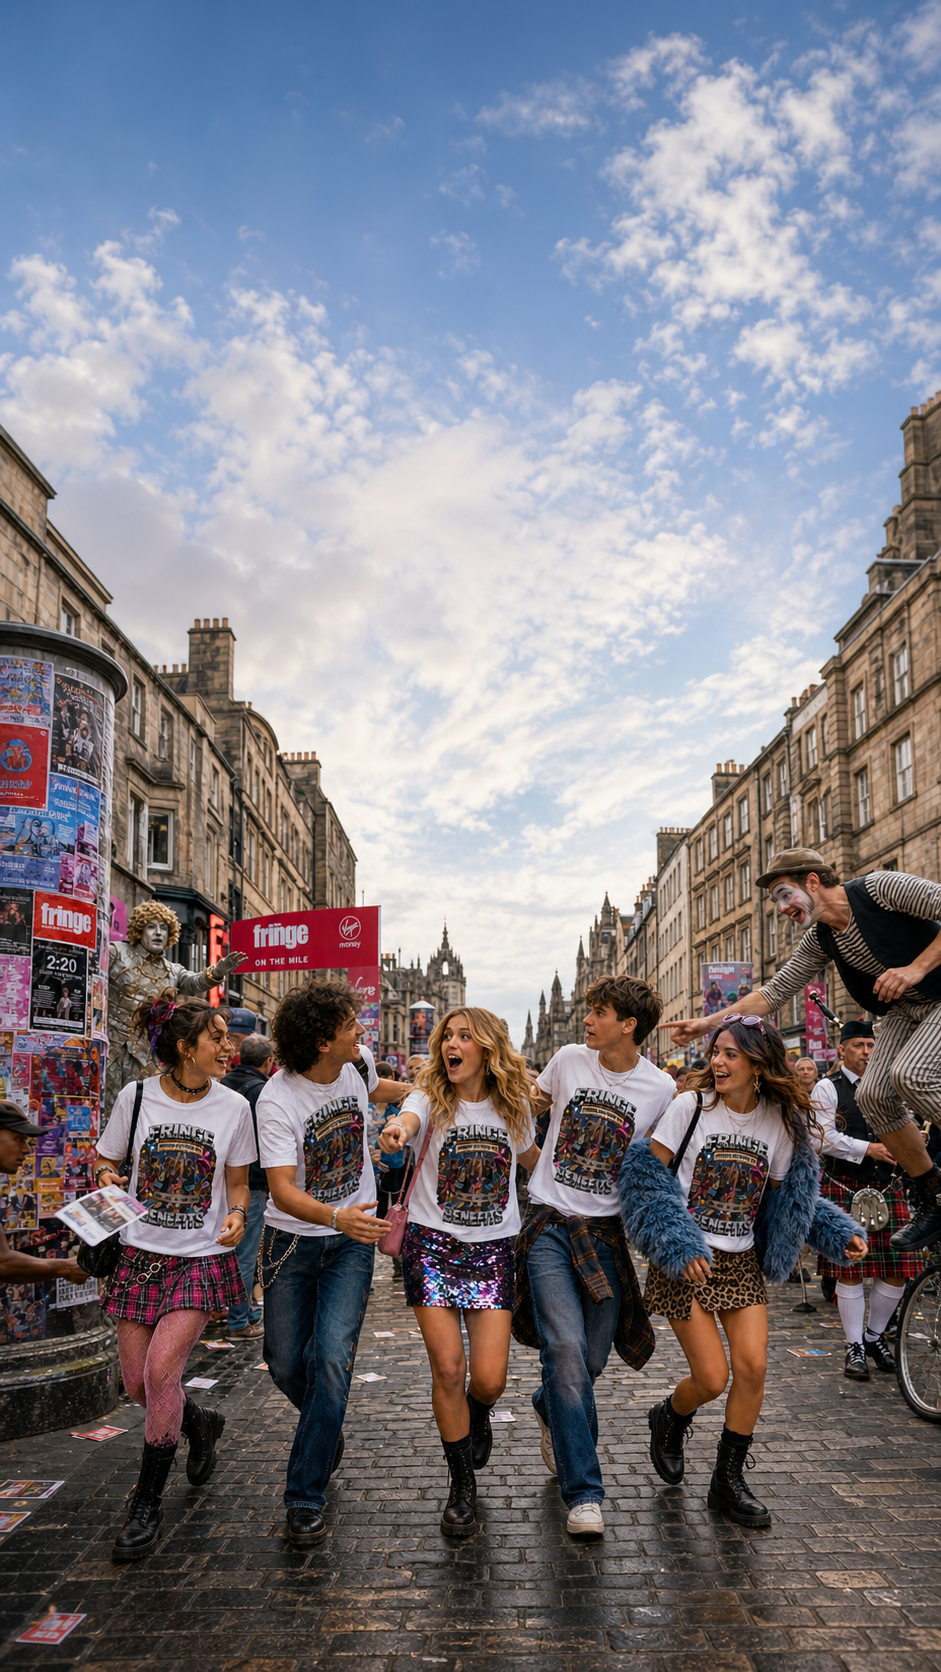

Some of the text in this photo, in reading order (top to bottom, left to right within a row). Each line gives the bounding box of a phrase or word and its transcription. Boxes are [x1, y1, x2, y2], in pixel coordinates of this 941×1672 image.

[46, 955, 77, 973] 2:20
[254, 955, 308, 967] ON THE MILE
[573, 1088, 638, 1119] FRINGE
[303, 1095, 359, 1136] FRINGE
[148, 1123, 215, 1147] FRINGE
[446, 1124, 508, 1144] FRINGE
[705, 1133, 769, 1156] FRINGE
